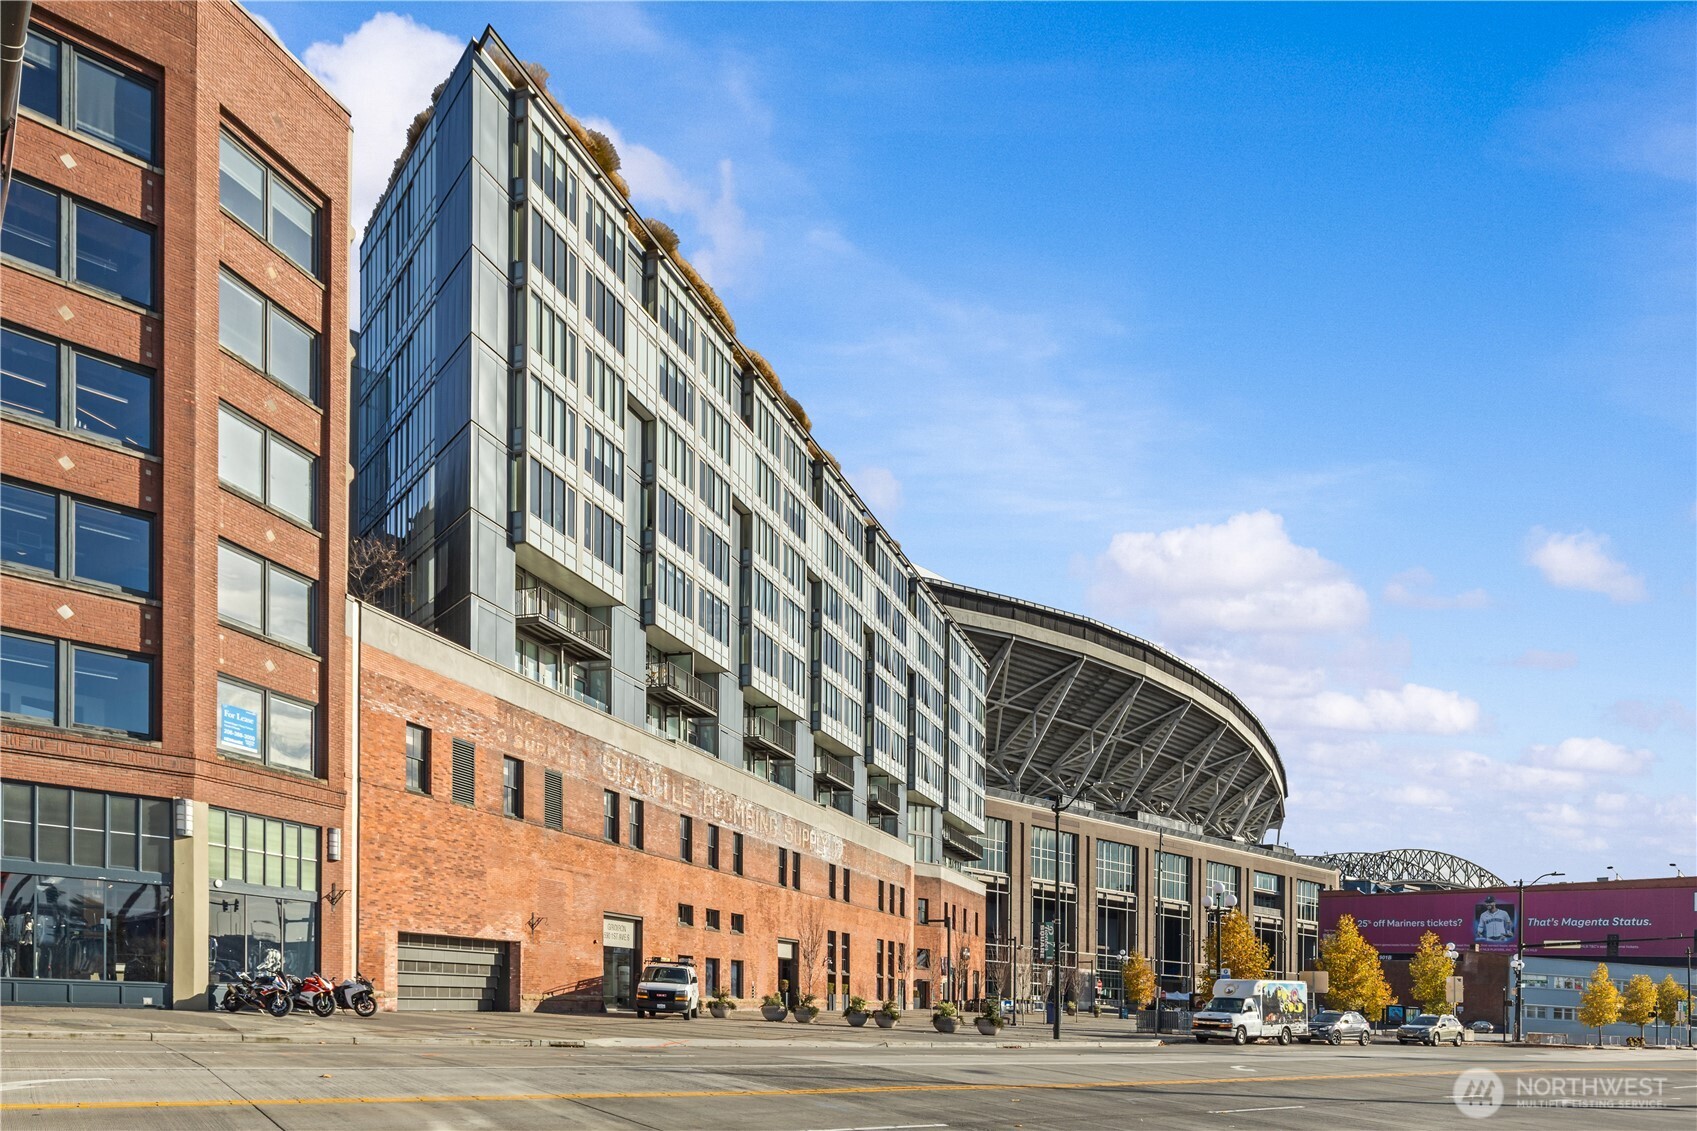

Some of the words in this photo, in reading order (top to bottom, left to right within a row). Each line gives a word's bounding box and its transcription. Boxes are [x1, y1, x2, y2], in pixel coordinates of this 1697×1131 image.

[224, 710, 235, 718] For
[237, 713, 254, 724] Lease
[1373, 919, 1386, 928] off
[1387, 919, 1425, 928] Mariners
[1427, 918, 1463, 927] tickets?
[1527, 917, 1559, 927] That's
[1561, 917, 1609, 928] Magenta
[1612, 916, 1652, 926] Status.
